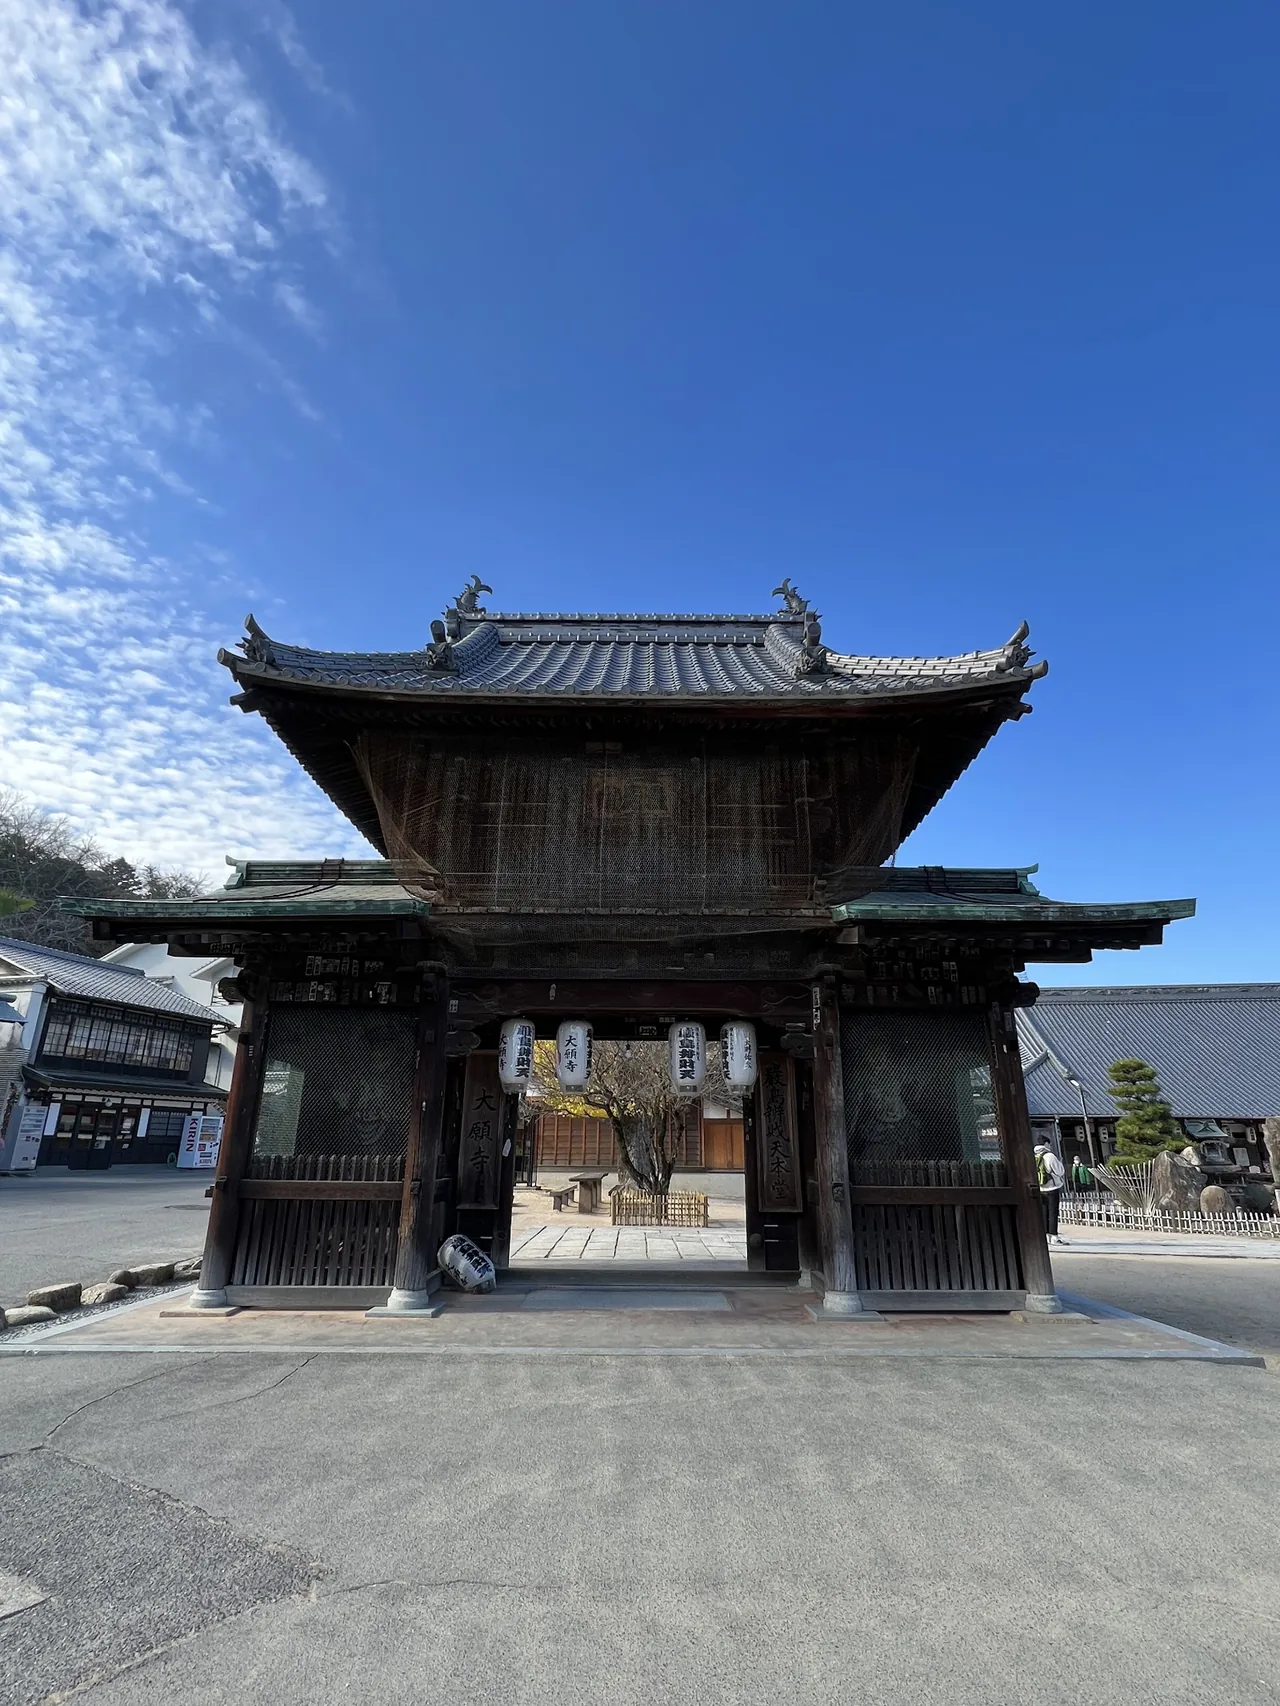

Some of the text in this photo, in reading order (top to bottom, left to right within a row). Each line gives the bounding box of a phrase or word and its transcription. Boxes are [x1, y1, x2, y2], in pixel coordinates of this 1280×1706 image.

[564, 1035, 578, 1073] 大願寺
[186, 1118, 199, 1152] KIRIN
[468, 1088, 498, 1174] 大願寺
